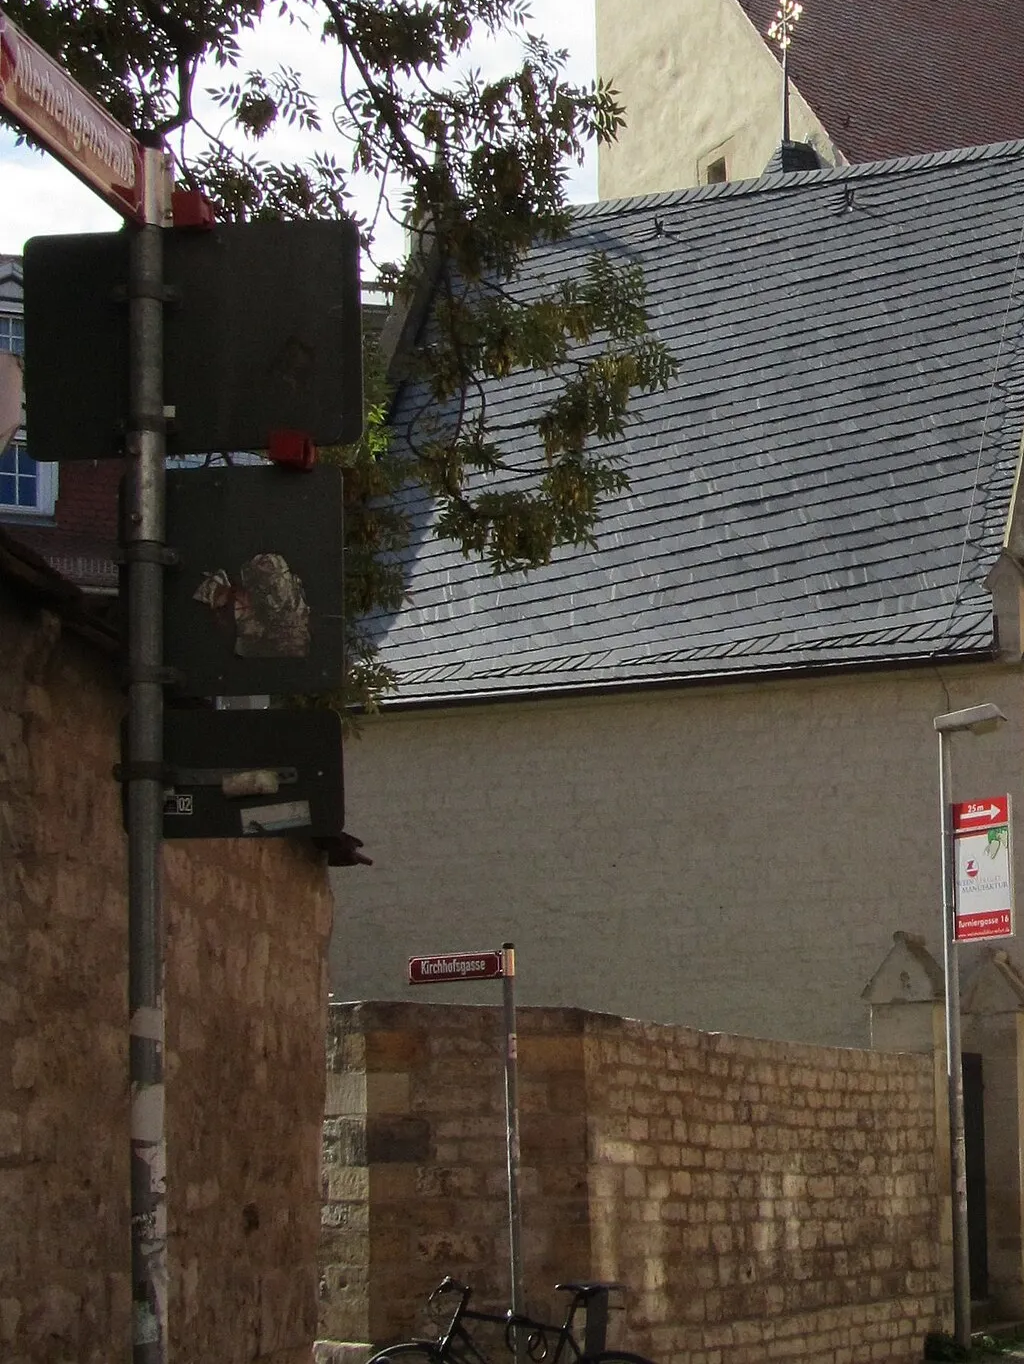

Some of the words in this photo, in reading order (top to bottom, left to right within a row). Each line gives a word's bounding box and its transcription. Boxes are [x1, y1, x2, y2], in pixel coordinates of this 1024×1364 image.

[179, 797, 192, 811] 02
[1001, 915, 1010, 923] 16
[421, 959, 486, 975] Kirchhofsgasse
